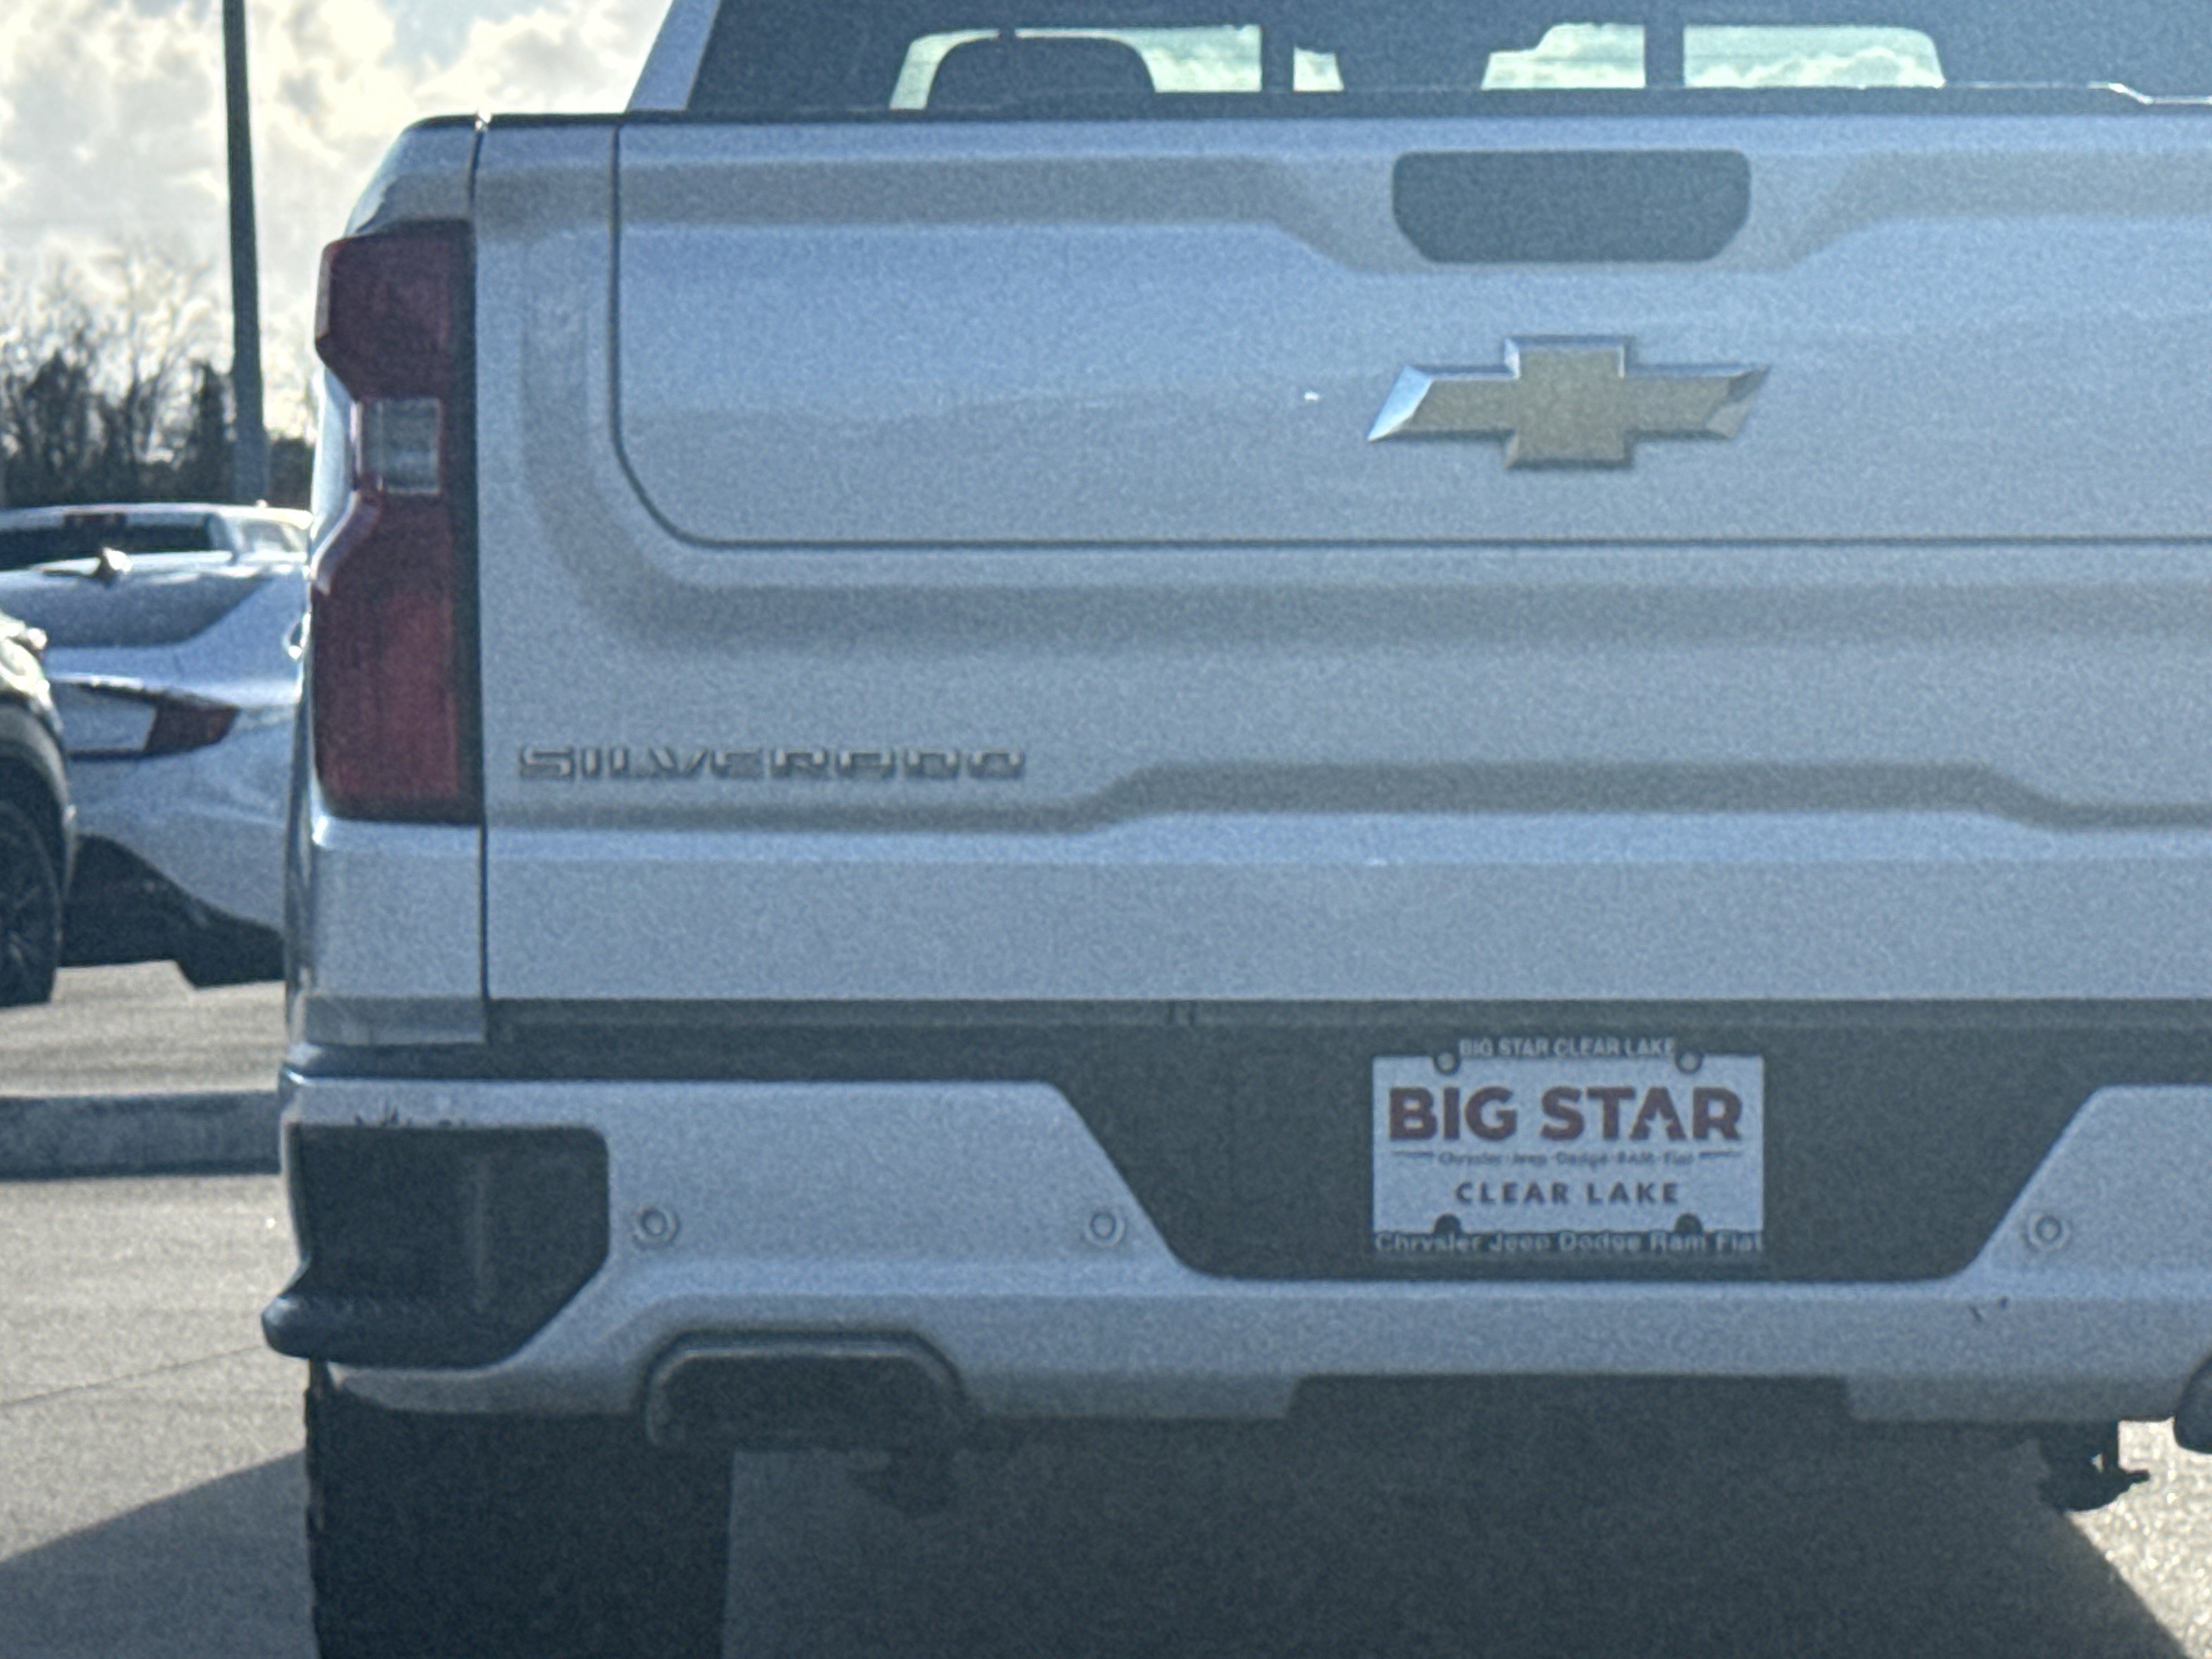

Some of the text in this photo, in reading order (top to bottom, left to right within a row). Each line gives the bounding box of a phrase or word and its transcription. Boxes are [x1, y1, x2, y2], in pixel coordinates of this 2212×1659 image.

[518, 746, 1025, 778] SILVERADO
[1458, 1037, 1676, 1057] BIG STAR CLEAR LAKE
[1389, 1086, 1743, 1141] BIG STAR
[1455, 1181, 1679, 1205] CLEAR LAKE
[1375, 1232, 1480, 1254] Chrysler
[1558, 1232, 1643, 1254] Dodge
[1650, 1232, 1706, 1252] Ram
